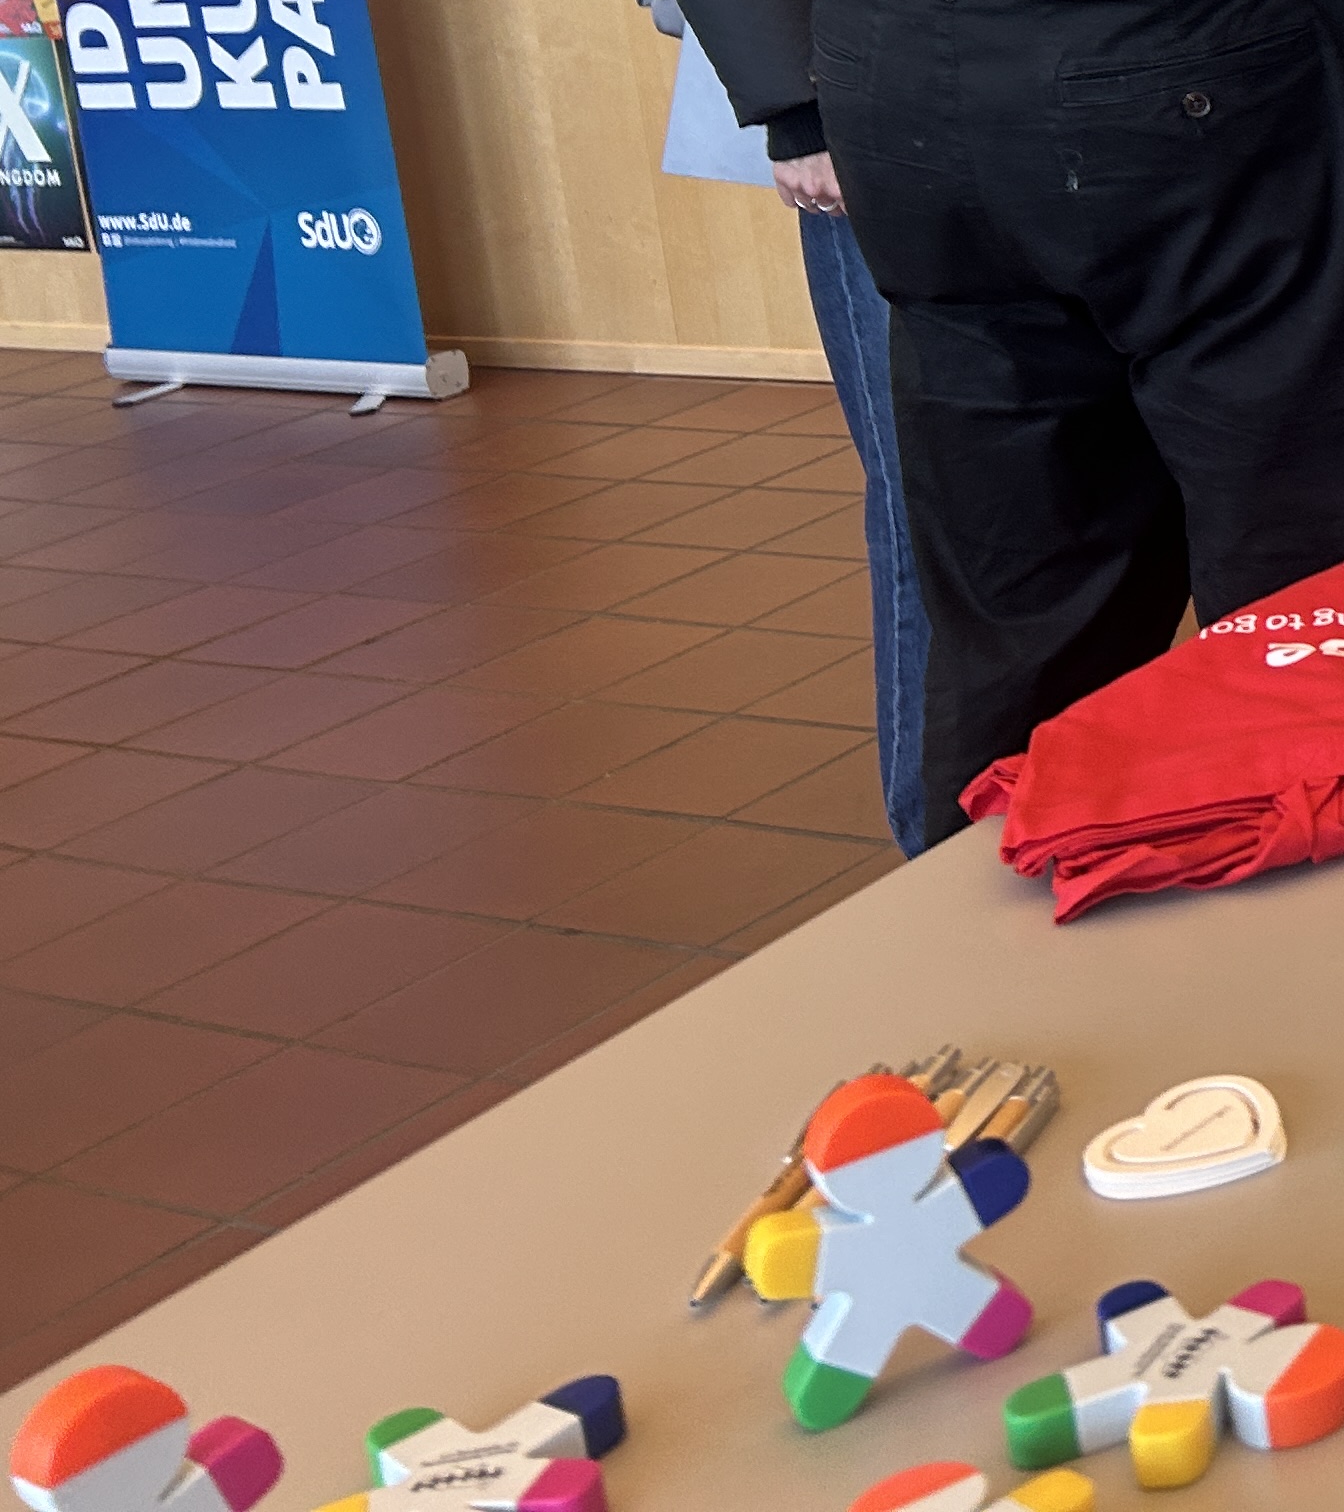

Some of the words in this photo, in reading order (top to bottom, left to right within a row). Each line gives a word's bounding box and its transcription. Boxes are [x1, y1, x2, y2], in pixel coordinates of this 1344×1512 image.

[98, 212, 192, 232] www.SdU.de
[297, 210, 353, 250] SdU
[1270, 612, 1302, 631] to
